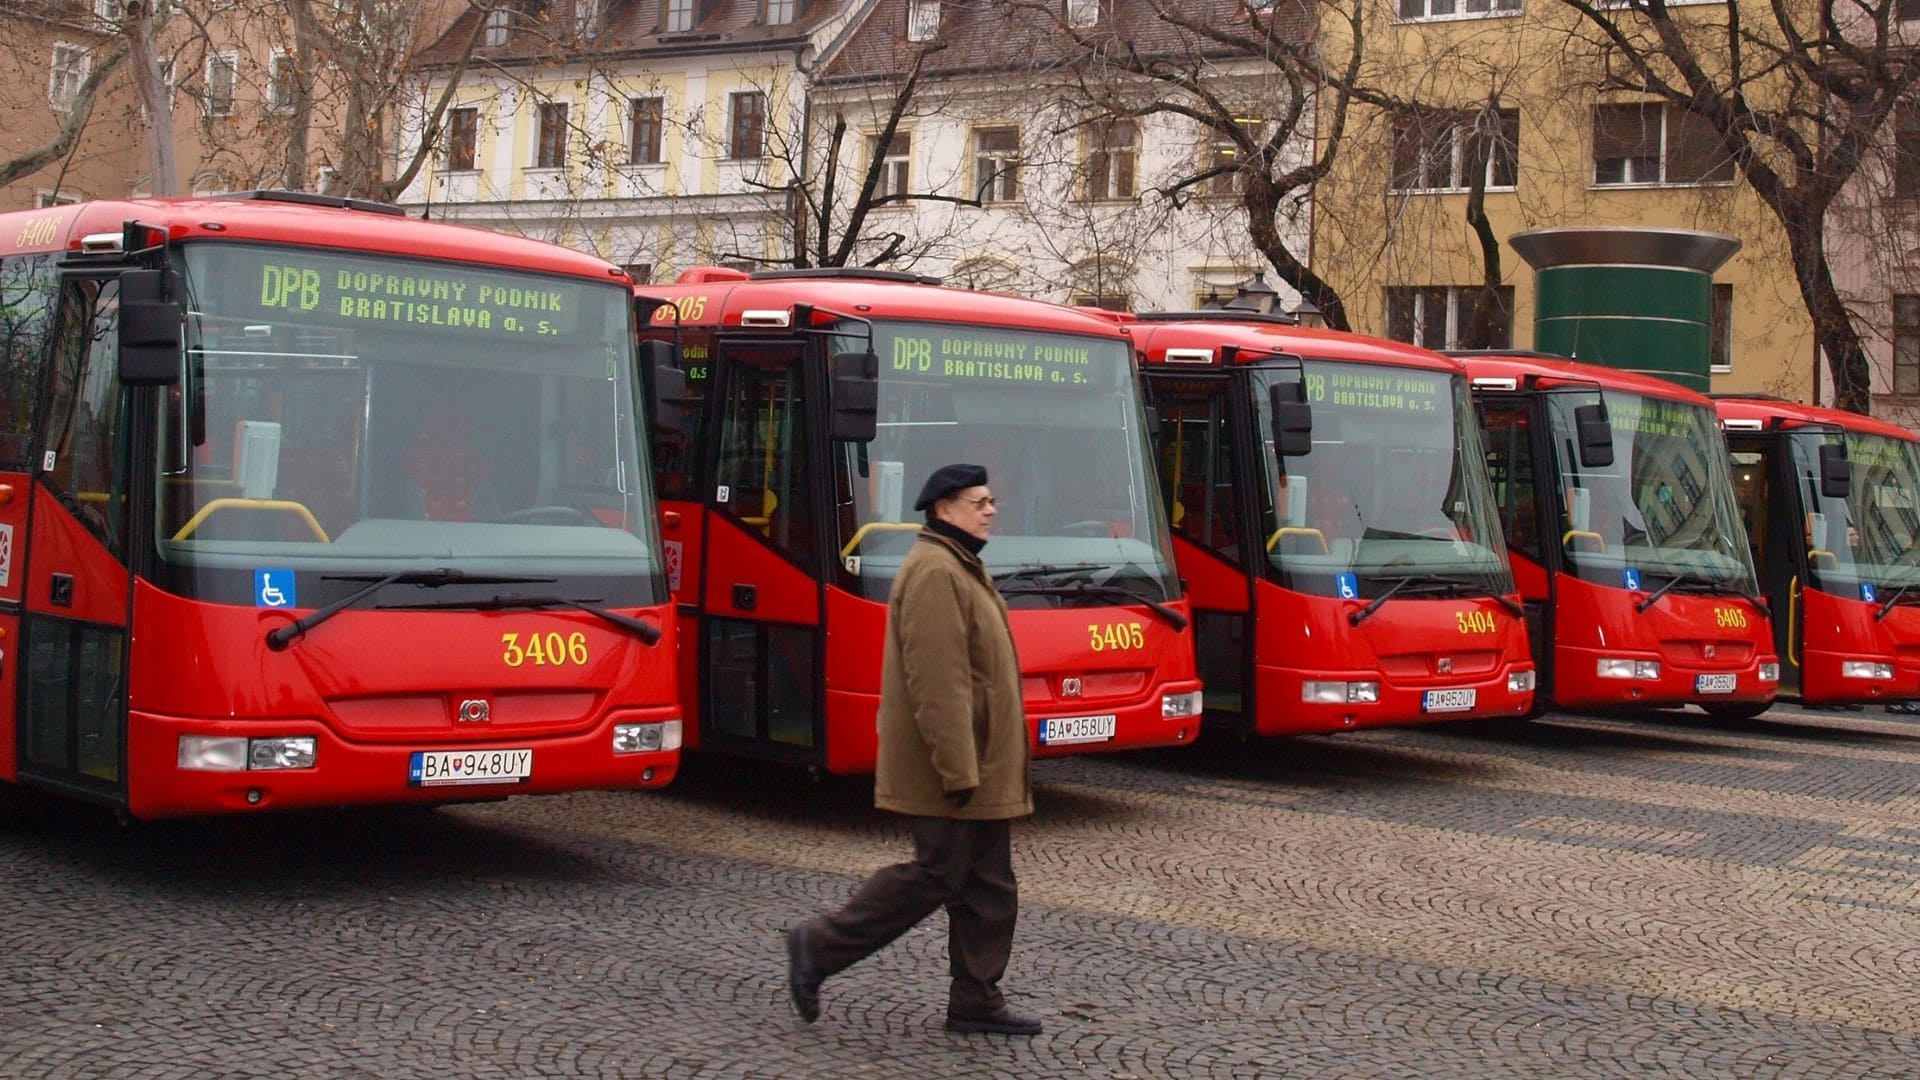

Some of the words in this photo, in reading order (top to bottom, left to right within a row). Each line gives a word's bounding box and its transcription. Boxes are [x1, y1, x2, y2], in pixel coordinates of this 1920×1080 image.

[261, 265, 320, 310] DPB
[479, 286, 562, 312] PODNIK
[340, 296, 491, 329] BRATISLAVA
[893, 336, 932, 372] DPB
[1034, 345, 1089, 365] PODNIK
[944, 359, 1043, 381] BRATISLAVA
[1304, 373, 1325, 402] PB
[1333, 390, 1403, 409] BRATISLAVA
[1456, 610, 1496, 634] 3404
[1714, 607, 1746, 628] 3403
[501, 631, 588, 667] 3406
[1088, 622, 1144, 651] 3405
